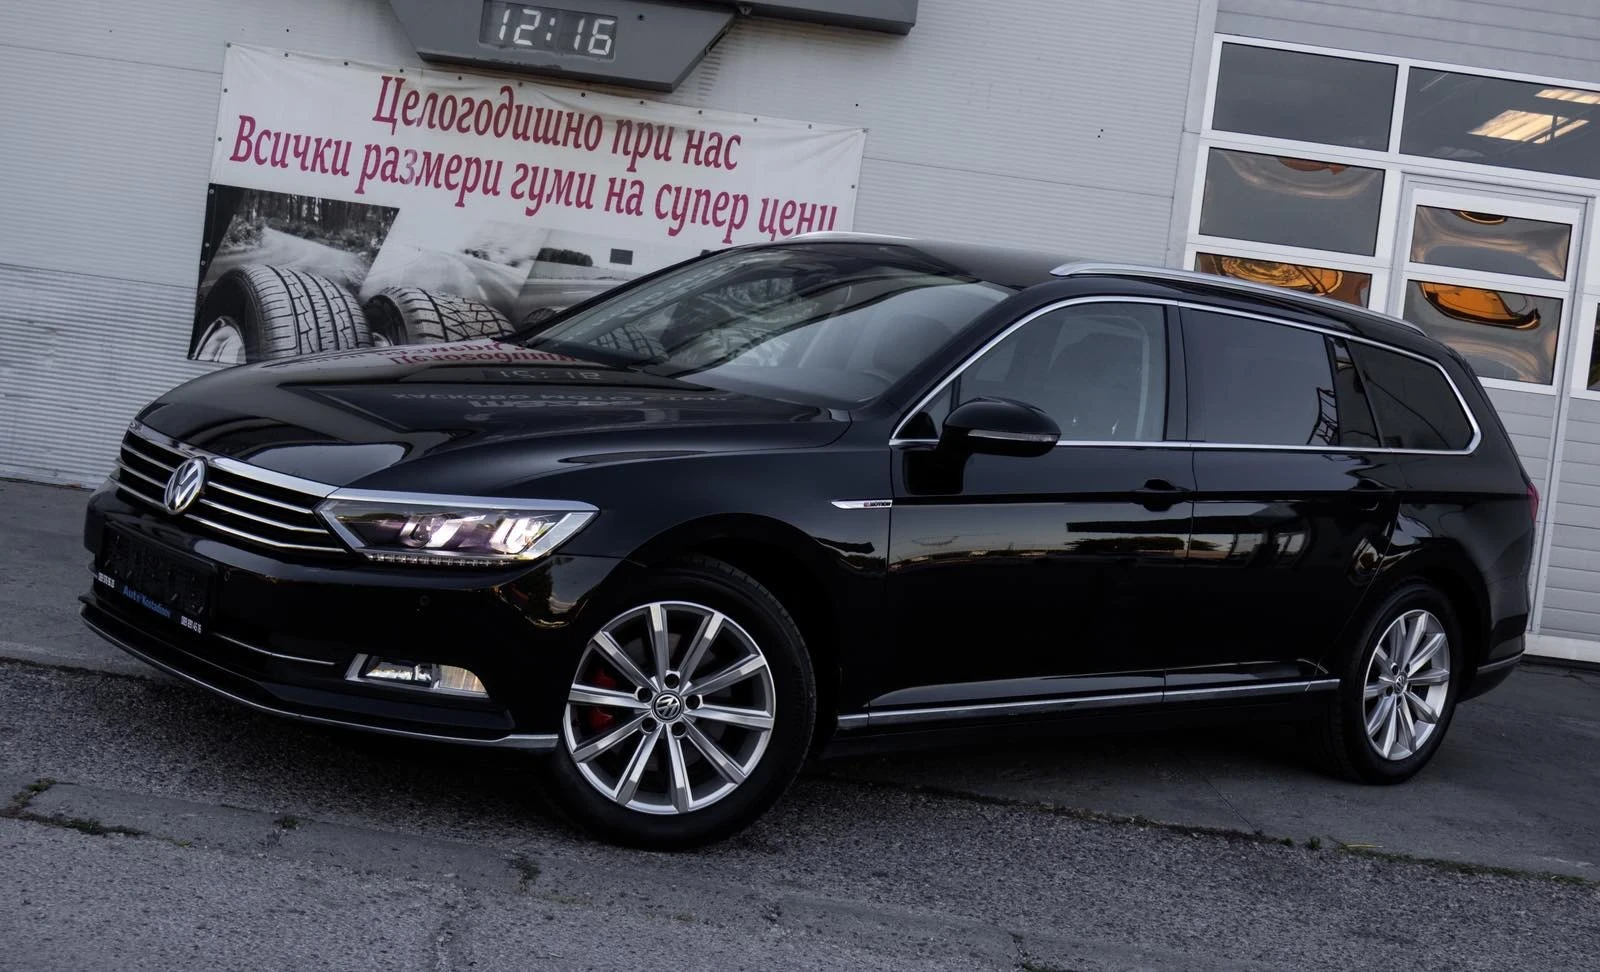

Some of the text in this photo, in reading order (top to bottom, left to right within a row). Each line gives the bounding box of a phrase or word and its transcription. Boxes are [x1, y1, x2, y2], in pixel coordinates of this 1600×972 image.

[499, 8, 615, 56] 12:16
[372, 75, 742, 173] Целогодишно при нас
[229, 114, 838, 245] Всички размери гуми на супер цени
